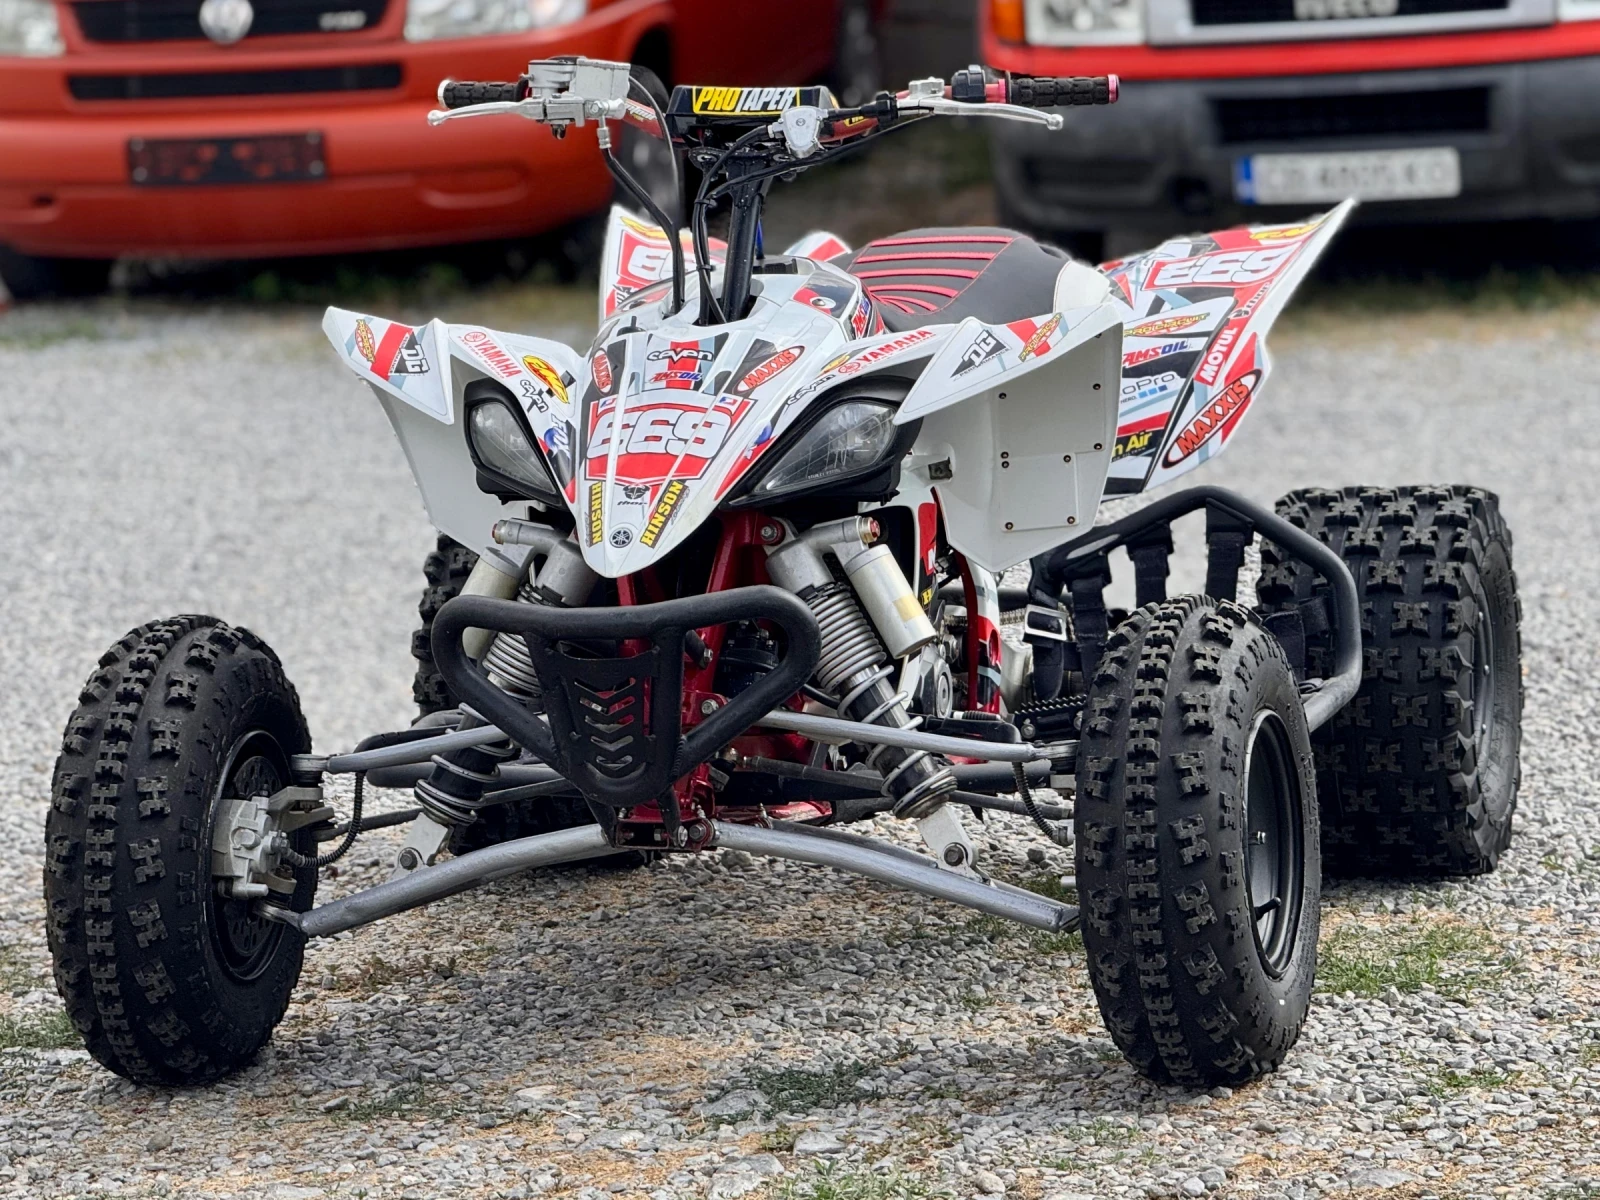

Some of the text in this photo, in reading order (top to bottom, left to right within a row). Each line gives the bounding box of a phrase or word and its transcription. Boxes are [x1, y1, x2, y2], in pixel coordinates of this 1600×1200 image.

[474, 339, 523, 378] YAMAHA
[857, 329, 933, 363] YAMAHA
[1122, 340, 1189, 367] AMSOIL
[1199, 327, 1238, 383] MOTUL
[650, 371, 702, 383] AMSOIL
[743, 350, 797, 390] MAXXIS
[1121, 372, 1176, 396] oPro
[587, 408, 732, 459] 669
[1176, 379, 1250, 457] MAXXIS
[1126, 431, 1152, 452] Air
[592, 481, 603, 544] HINSON
[640, 480, 684, 548] HINSON
